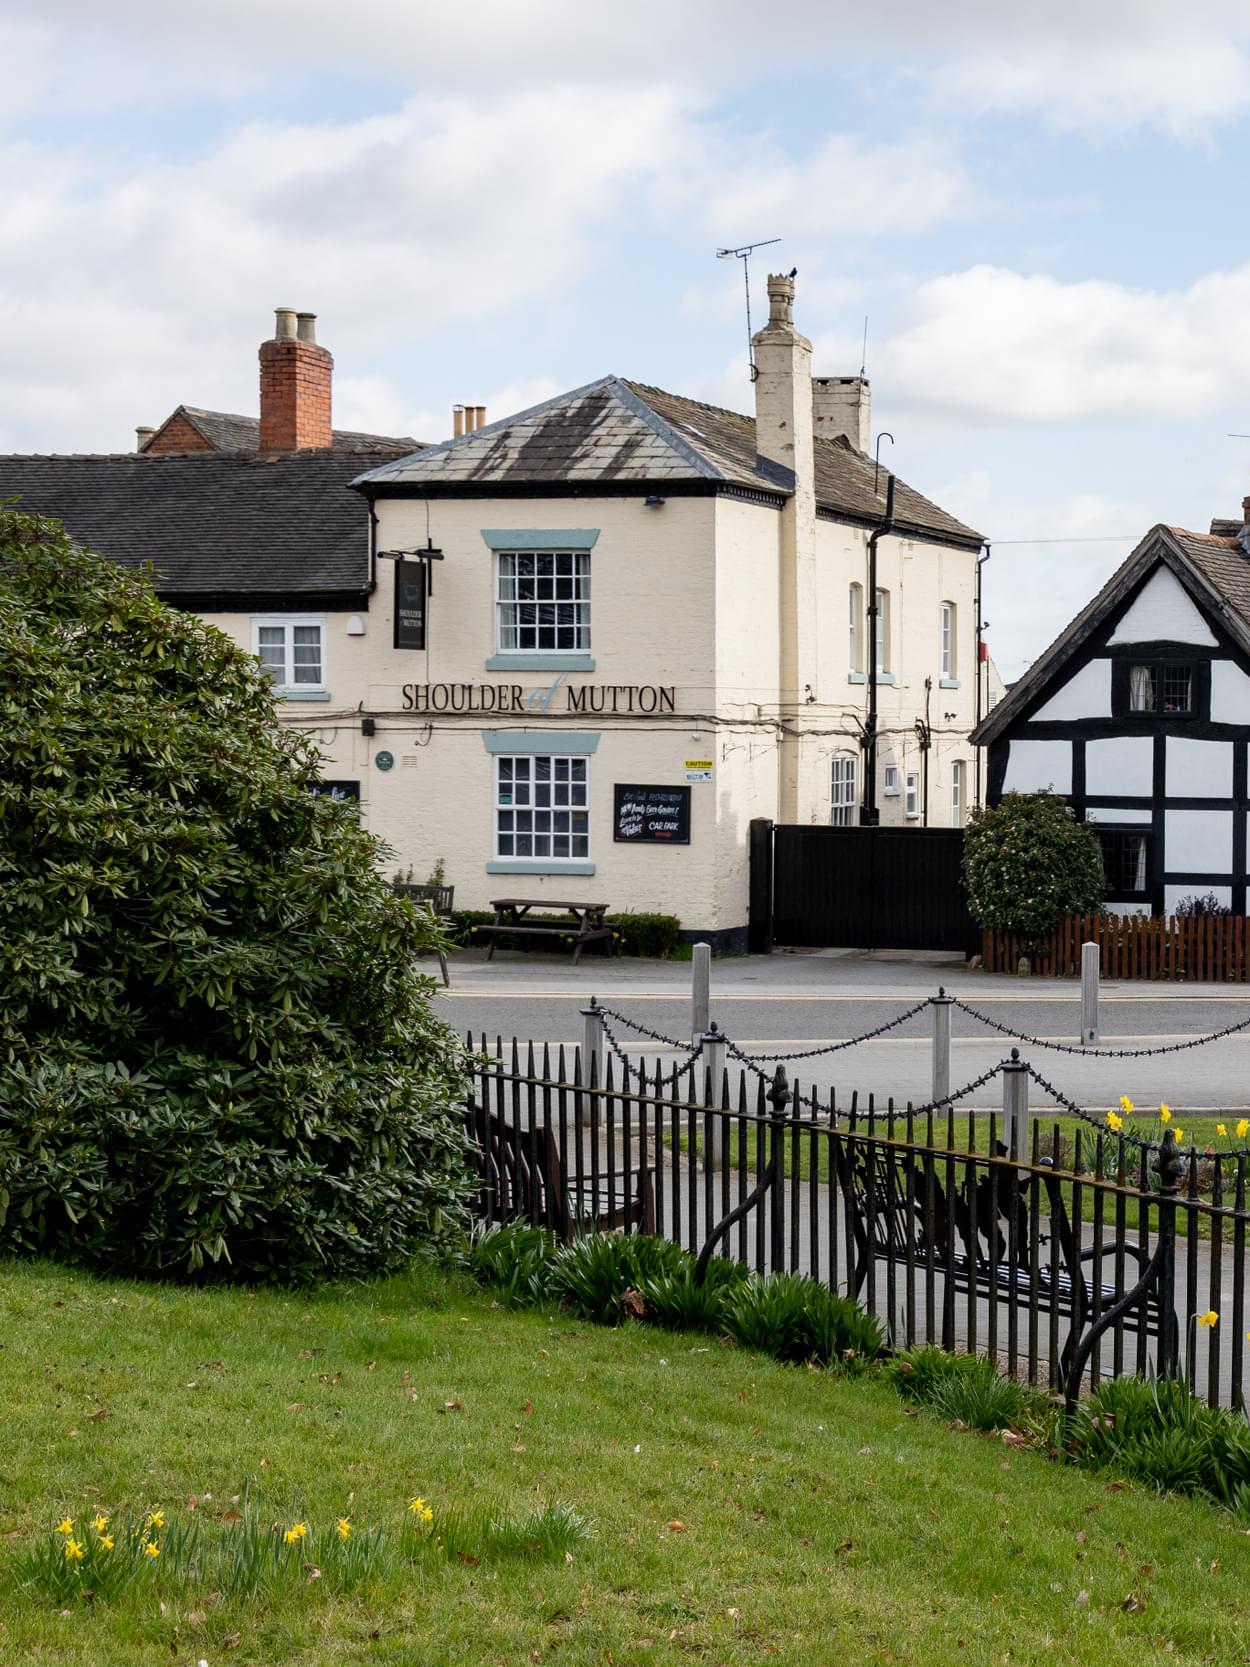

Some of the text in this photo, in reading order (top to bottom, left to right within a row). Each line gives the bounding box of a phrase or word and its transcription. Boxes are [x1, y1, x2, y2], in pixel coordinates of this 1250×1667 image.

[402, 671, 676, 712] SHOULDER of MUTTON
[648, 821, 663, 830] CAR
[663, 821, 680, 831] PARK
